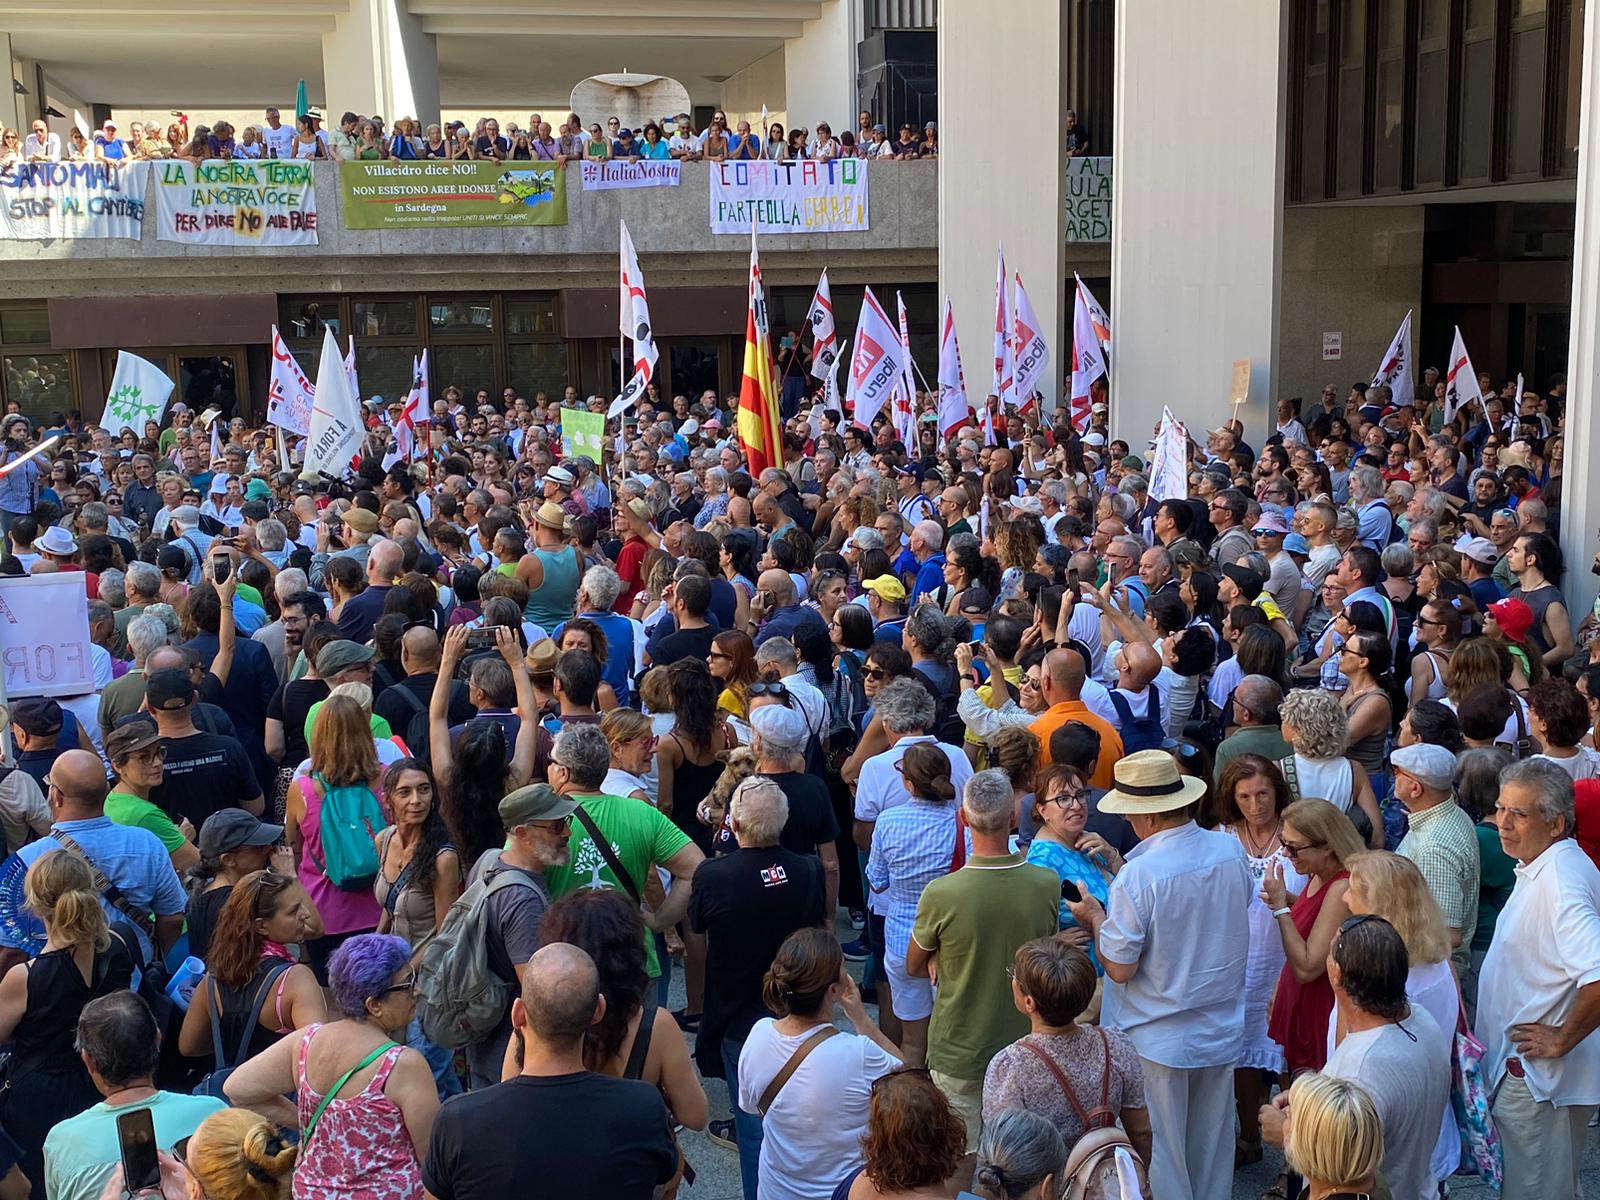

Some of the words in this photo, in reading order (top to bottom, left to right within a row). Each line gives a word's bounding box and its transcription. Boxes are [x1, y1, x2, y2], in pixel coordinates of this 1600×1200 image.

[164, 164, 187, 185] LA
[197, 162, 259, 185] NOSTRA
[259, 162, 313, 185] TERRA
[364, 164, 422, 176] Villacidro
[425, 164, 449, 175] dice
[452, 164, 477, 175] NO!!
[257, 186, 300, 206] VOCE
[352, 186, 376, 196] NON
[378, 185, 428, 195] ESISTONO
[431, 184, 457, 194] AREE
[458, 184, 497, 194] IDONEE
[9, 197, 54, 220] STOP
[394, 203, 404, 212] in
[406, 203, 447, 214] Sardegna
[175, 212, 201, 233] PER
[240, 209, 262, 232] NO
